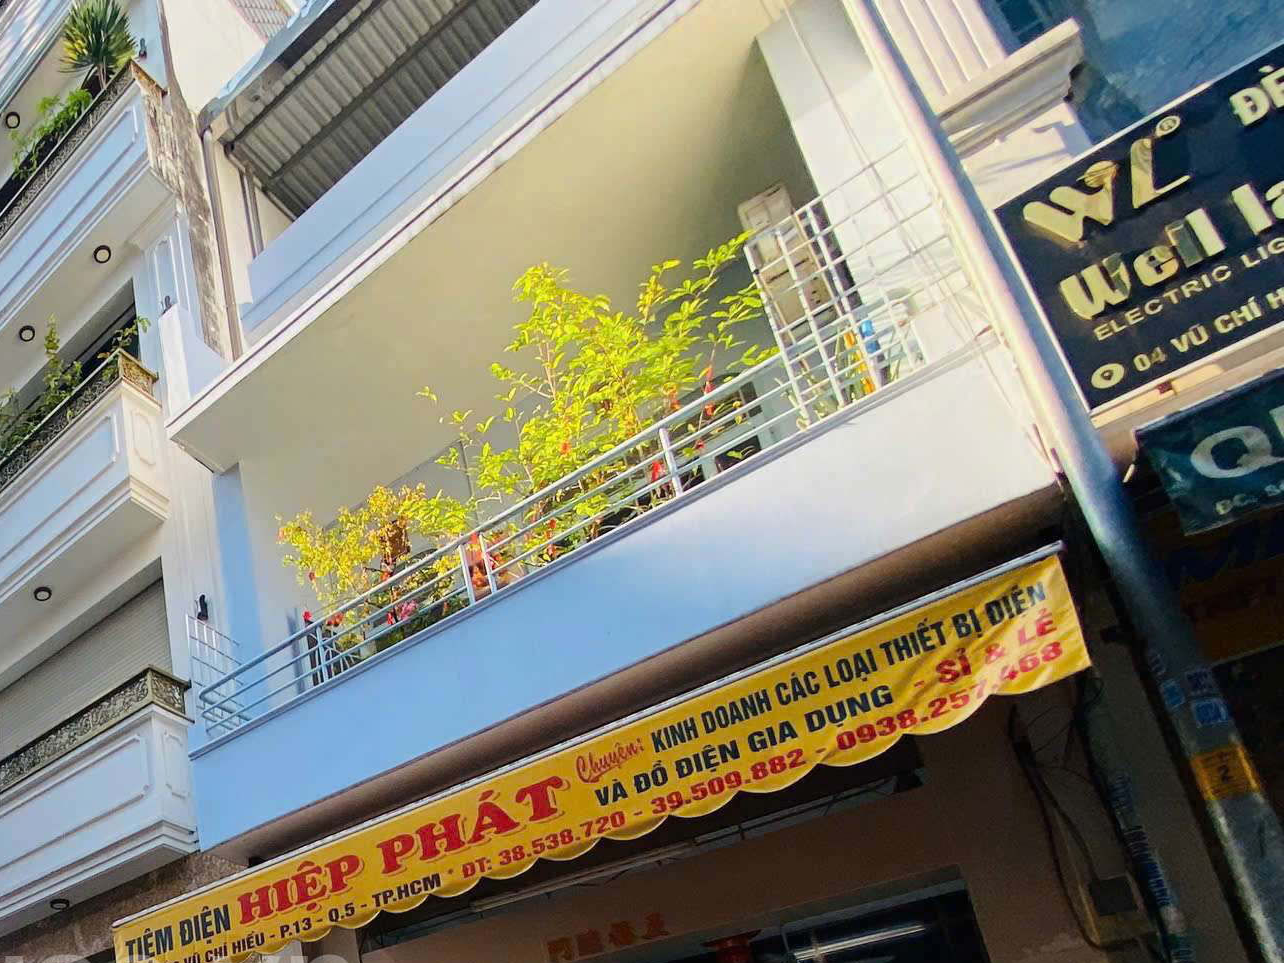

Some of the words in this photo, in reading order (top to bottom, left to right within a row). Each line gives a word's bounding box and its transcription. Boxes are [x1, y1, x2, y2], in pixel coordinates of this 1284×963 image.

[1059, 207, 1226, 320] Well
[1093, 264, 1232, 342] ELECTRIC
[1133, 346, 1167, 372] 04
[1170, 322, 1209, 353] VŨ
[1213, 296, 1262, 334] CHÍ
[594, 778, 628, 806] VÀ
[633, 760, 668, 794] ĐỒ
[674, 739, 741, 779] ĐIỆN
[747, 720, 799, 753] GIA
[804, 684, 894, 733] DỤNG
[935, 647, 972, 684] SỈ
[1017, 608, 1058, 646] LẺ
[651, 716, 699, 753] KINH
[700, 689, 772, 734] DOANH
[774, 671, 821, 706] CÁC
[823, 648, 878, 688] LOẠI
[879, 617, 947, 666] THIẾT
[951, 608, 983, 638] BỊ
[984, 581, 1047, 627] ĐIỆN
[205, 943, 228, 963] CHÍ
[232, 930, 265, 954] HIẾU
[279, 917, 312, 939] P.13
[328, 903, 356, 923] Q.5
[371, 872, 441, 908] TP.HCM
[462, 860, 493, 879] ĐT:
[498, 810, 626, 867] 38.538.720
[650, 748, 807, 815] 39.509.882
[836, 641, 1064, 750] 0938.257.468
[237, 854, 364, 926] HIỆP
[376, 775, 569, 875] PHÁT
[179, 904, 231, 945] ĐIỆN
